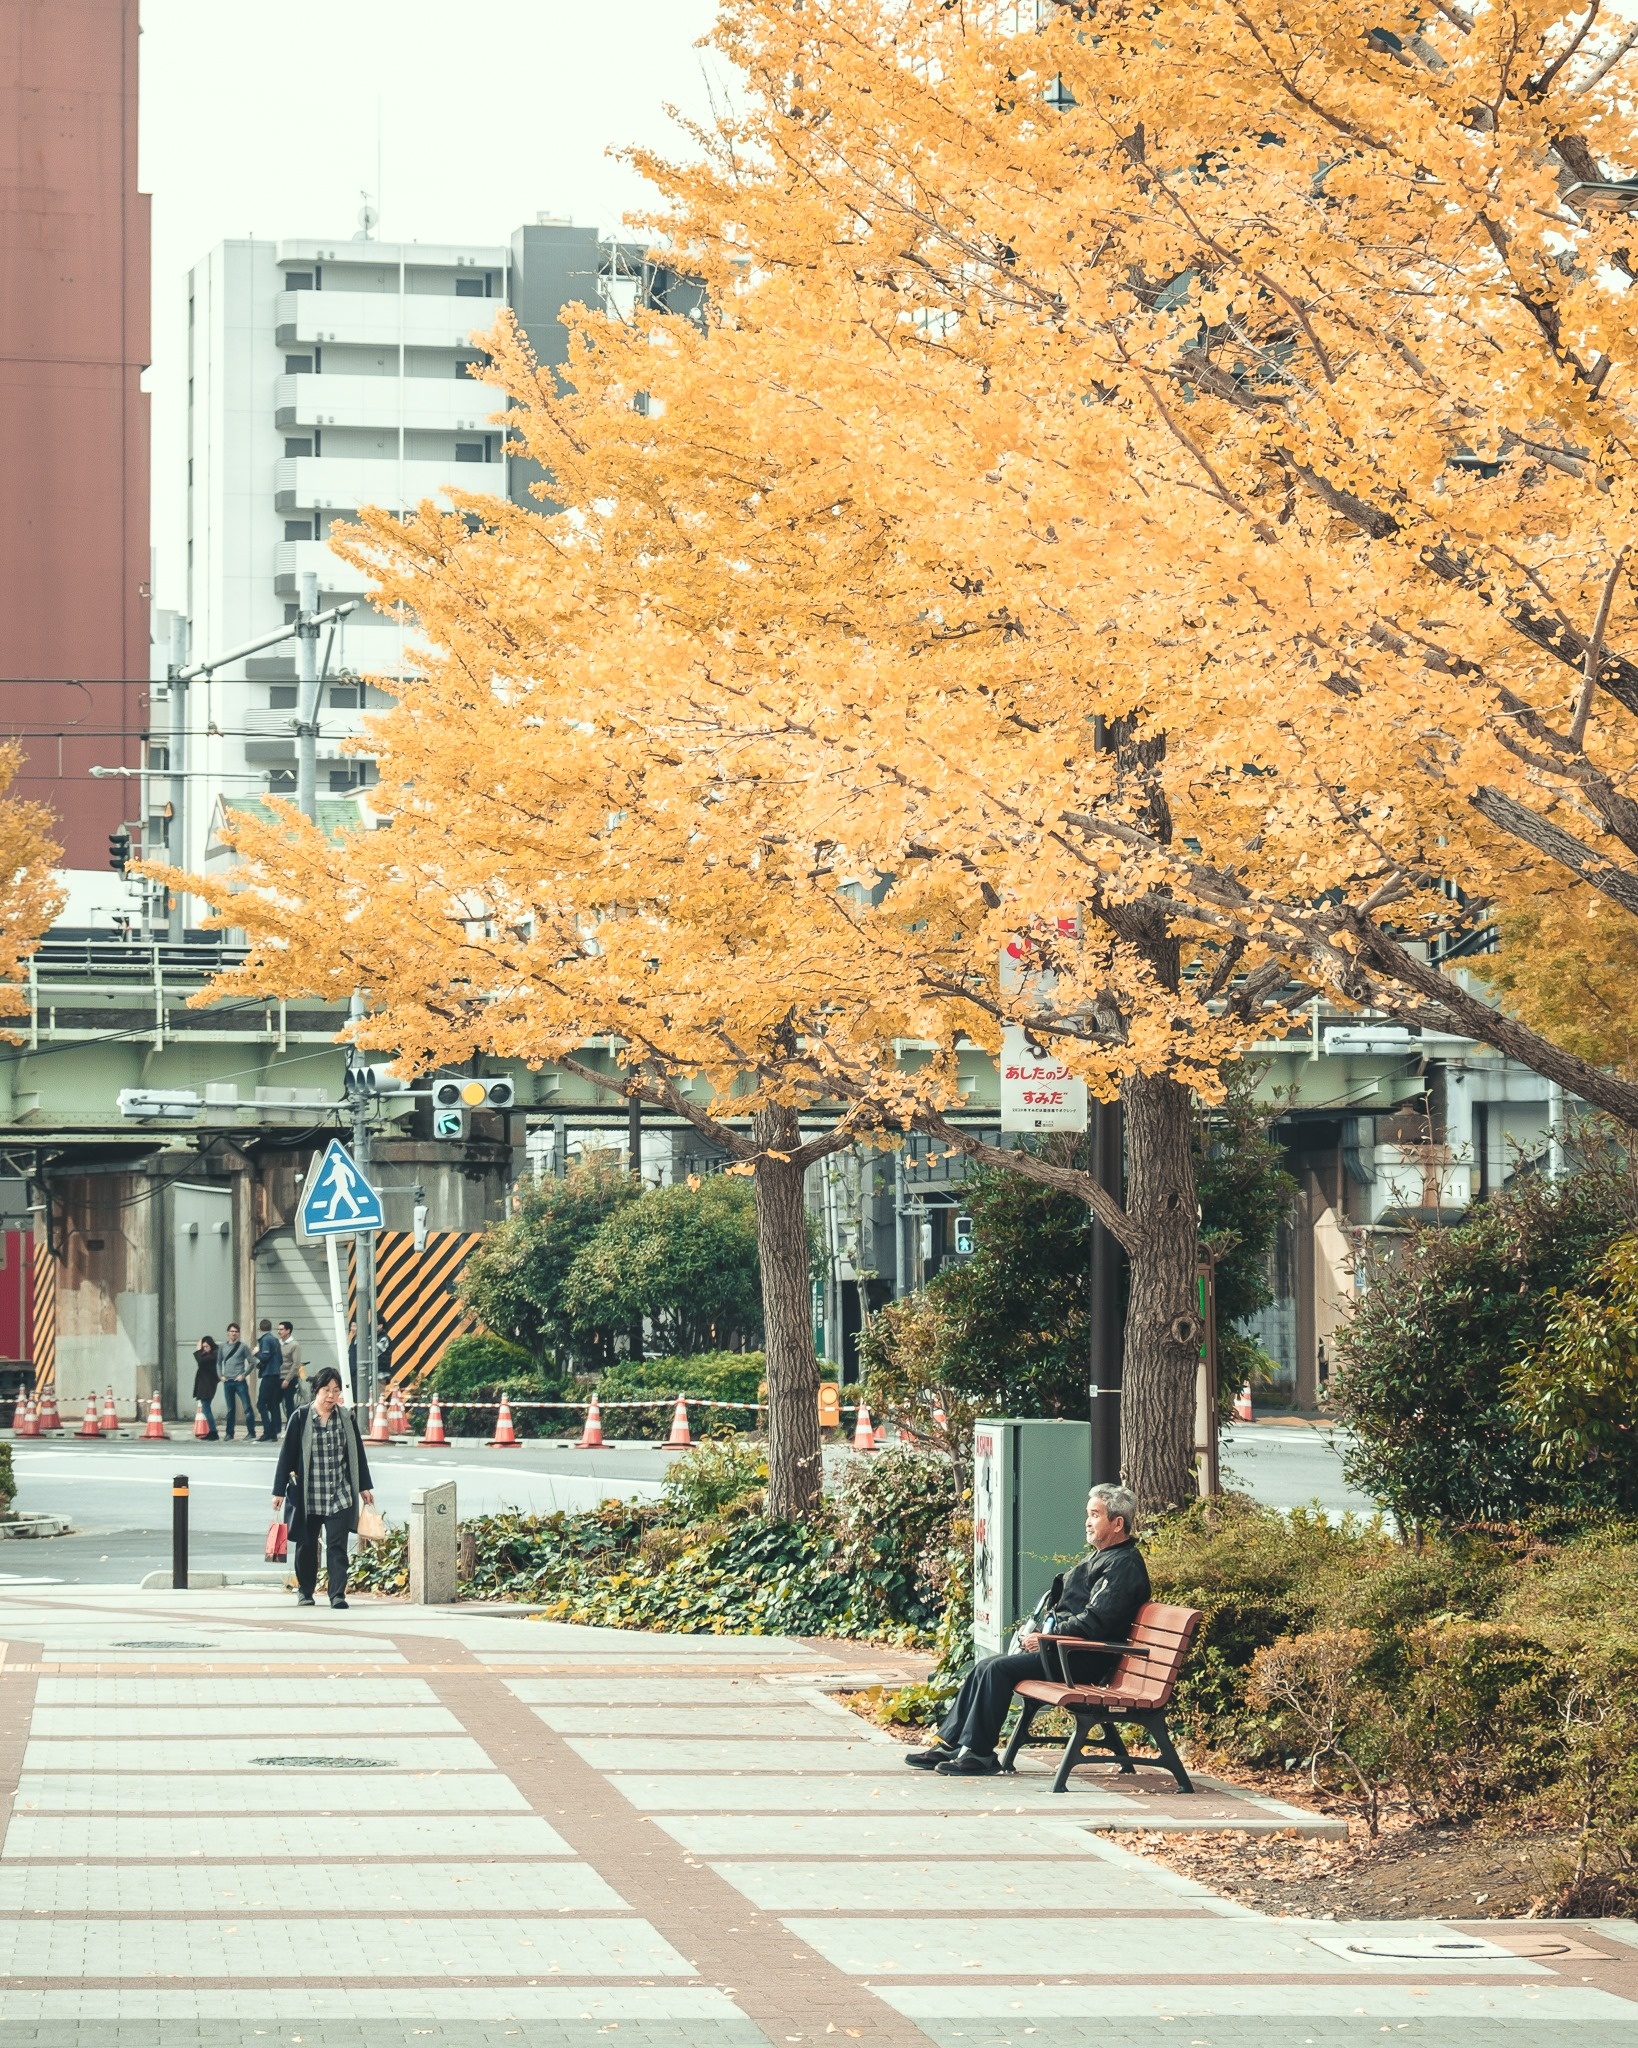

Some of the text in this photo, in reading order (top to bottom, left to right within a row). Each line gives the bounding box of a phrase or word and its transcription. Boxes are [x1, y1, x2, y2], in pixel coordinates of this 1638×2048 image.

[1005, 1066, 1074, 1080] あしたのジョ
[1022, 1091, 1068, 1104] すみだ
